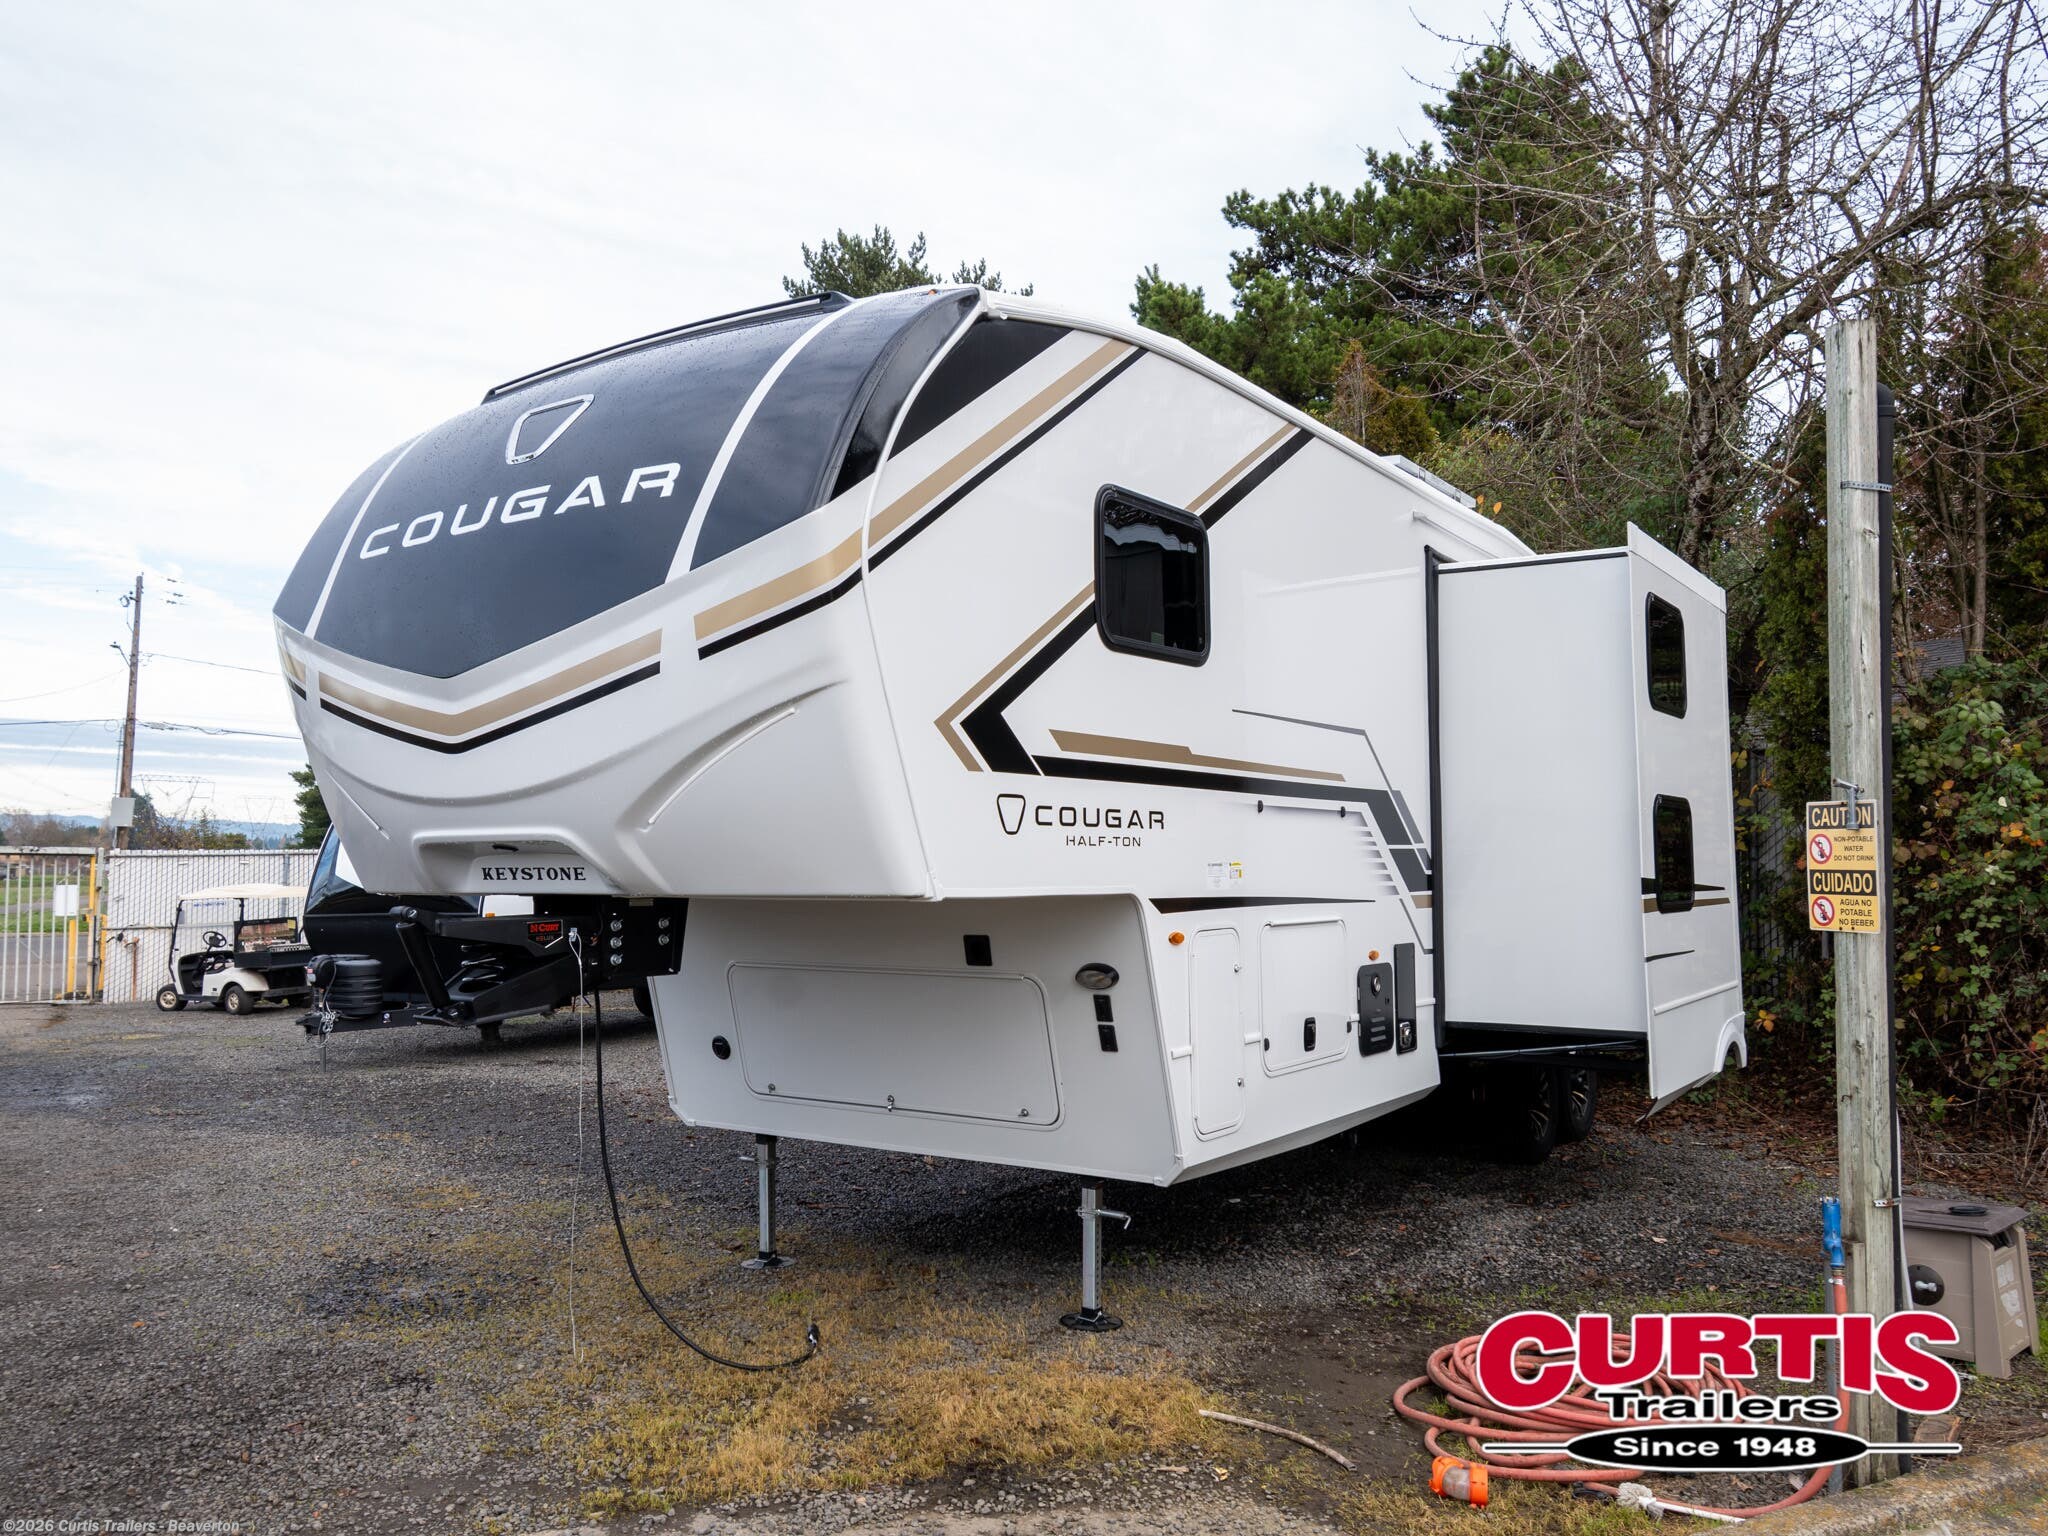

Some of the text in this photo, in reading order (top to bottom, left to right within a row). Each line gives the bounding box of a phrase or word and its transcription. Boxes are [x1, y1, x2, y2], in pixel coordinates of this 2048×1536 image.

[360, 462, 681, 559] COUGAR
[1035, 805, 1165, 829] COUGAR
[1811, 806, 1871, 827] CAUTON
[1065, 835, 1142, 847] HALF-TON
[482, 867, 586, 880] KEYSTONE
[1813, 872, 1873, 893] CUIDADO
[1840, 899, 1860, 907] AGUA
[1840, 908, 1872, 917] POTABLE
[1839, 917, 1874, 927] NO BEBER
